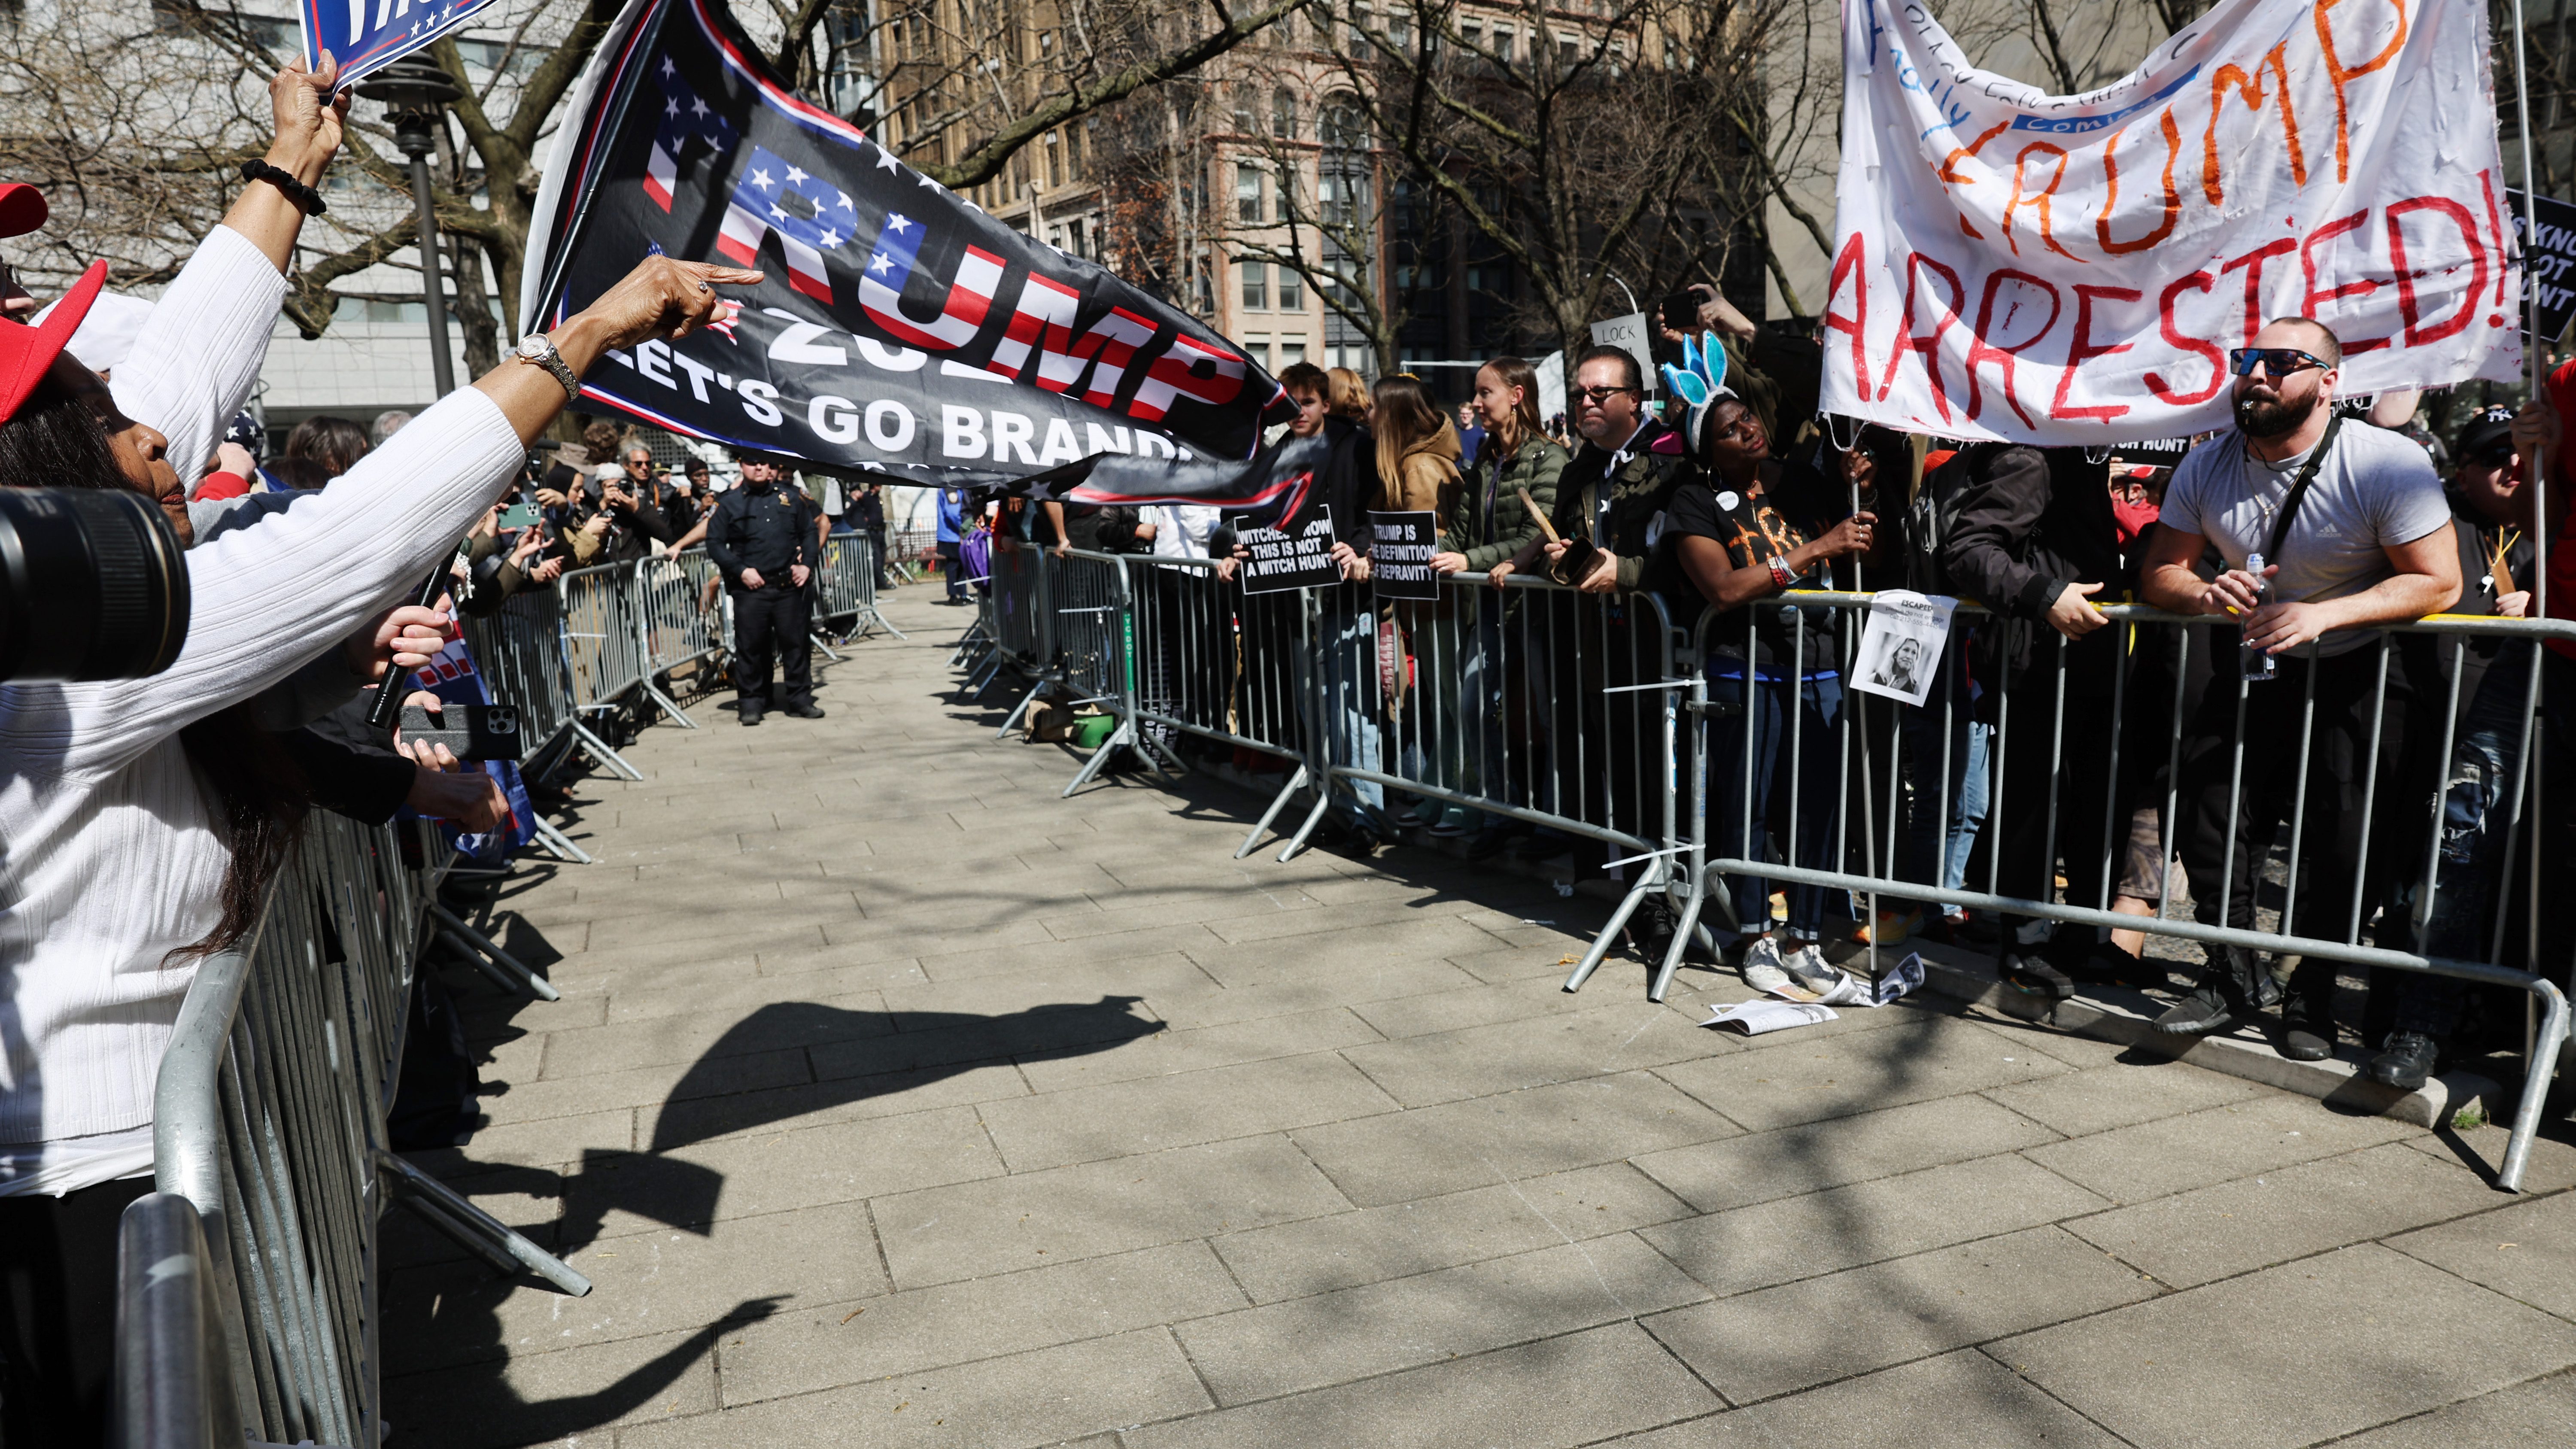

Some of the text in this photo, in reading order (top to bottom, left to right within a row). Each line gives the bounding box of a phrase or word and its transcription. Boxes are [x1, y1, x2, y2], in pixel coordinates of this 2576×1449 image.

[642, 48, 1248, 422] TRUMP
[1602, 325, 1636, 343] LOCK
[808, 395, 915, 452] GO
[941, 403, 1194, 467] BRAND
[2142, 438, 2187, 453] HUNT
[1374, 524, 1416, 541] TRUMP IS
[1251, 537, 1321, 559] THIS IS NOT
[1380, 544, 1436, 561] DEFINITION
[1247, 553, 1332, 577] A WITCH HUNT
[1380, 564, 1432, 581] DEPRAVITY
[1901, 600, 1933, 611] ESCAPED
